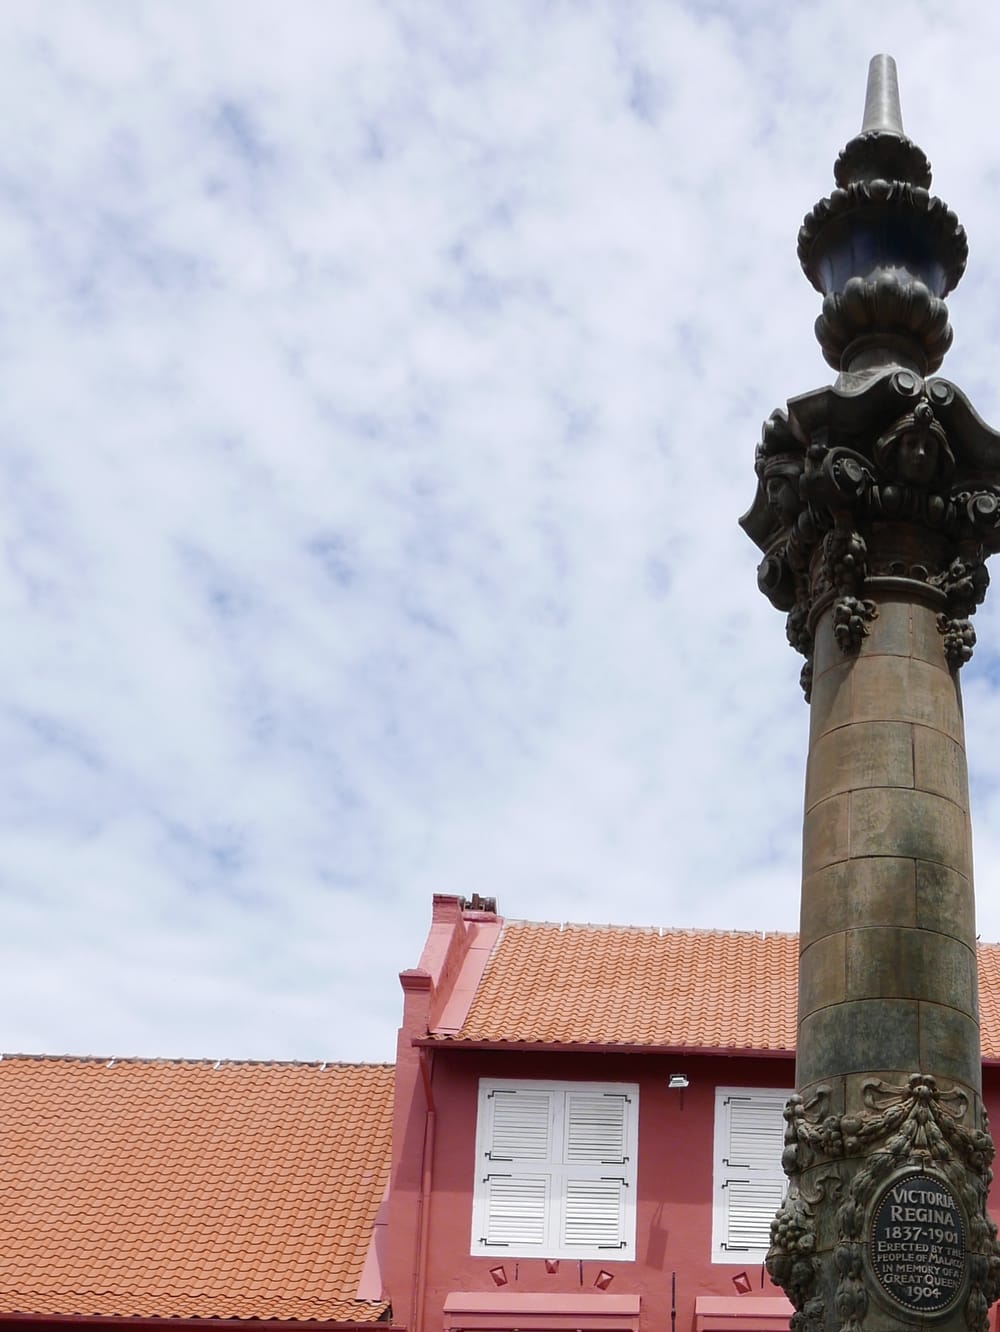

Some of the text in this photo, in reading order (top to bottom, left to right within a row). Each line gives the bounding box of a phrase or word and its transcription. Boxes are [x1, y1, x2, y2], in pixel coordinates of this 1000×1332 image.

[891, 1189, 956, 1210] VICTORIA
[890, 1205, 955, 1227] REGINA
[884, 1226, 958, 1244] 1837-1901
[877, 1241, 964, 1259] ERECTED BY THE
[877, 1253, 914, 1262] PEOPLE
[915, 1254, 928, 1262] OF
[882, 1264, 893, 1273] IN
[896, 1264, 940, 1275] MEMORY
[942, 1268, 953, 1277] OF
[883, 1273, 959, 1289] GREAT QUEEN
[907, 1286, 941, 1303] 1904
